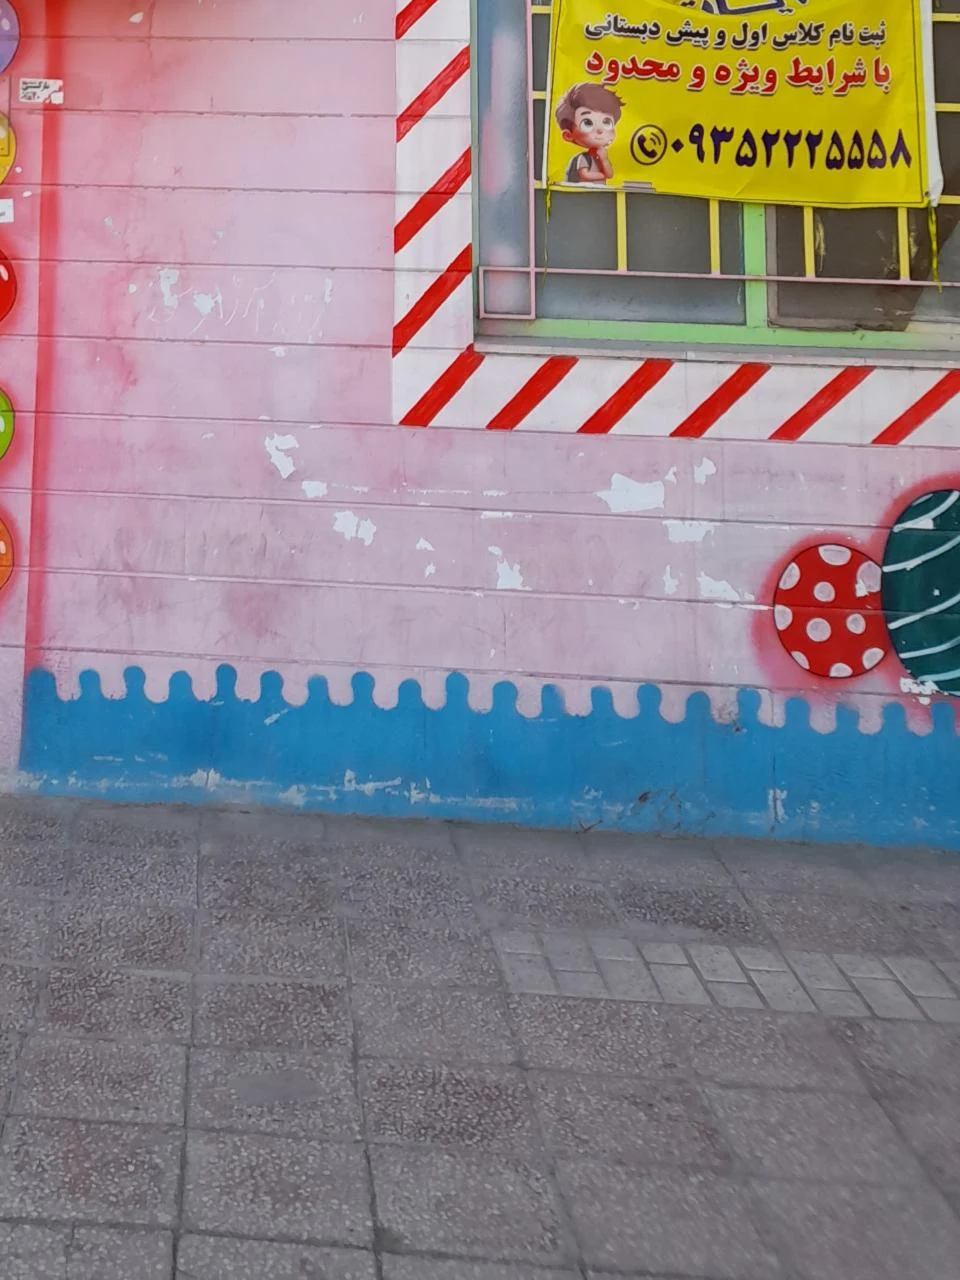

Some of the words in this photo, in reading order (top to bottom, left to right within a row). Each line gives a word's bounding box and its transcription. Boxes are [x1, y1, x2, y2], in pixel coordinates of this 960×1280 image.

[585, 14, 661, 42] دبستانی
[666, 20, 709, 47] پیش
[715, 28, 726, 46] و
[732, 22, 768, 47] اول
[773, 22, 825, 47] کلاس
[829, 24, 854, 48] نام
[859, 21, 886, 45] ثبت
[586, 51, 680, 84] محدود
[688, 65, 705, 89] و
[715, 58, 778, 93] ویژه
[786, 57, 866, 93] شرایط
[873, 57, 890, 92] با
[671, 123, 912, 170] ۰۹۳۵۲۲۲۵۵۵۸
